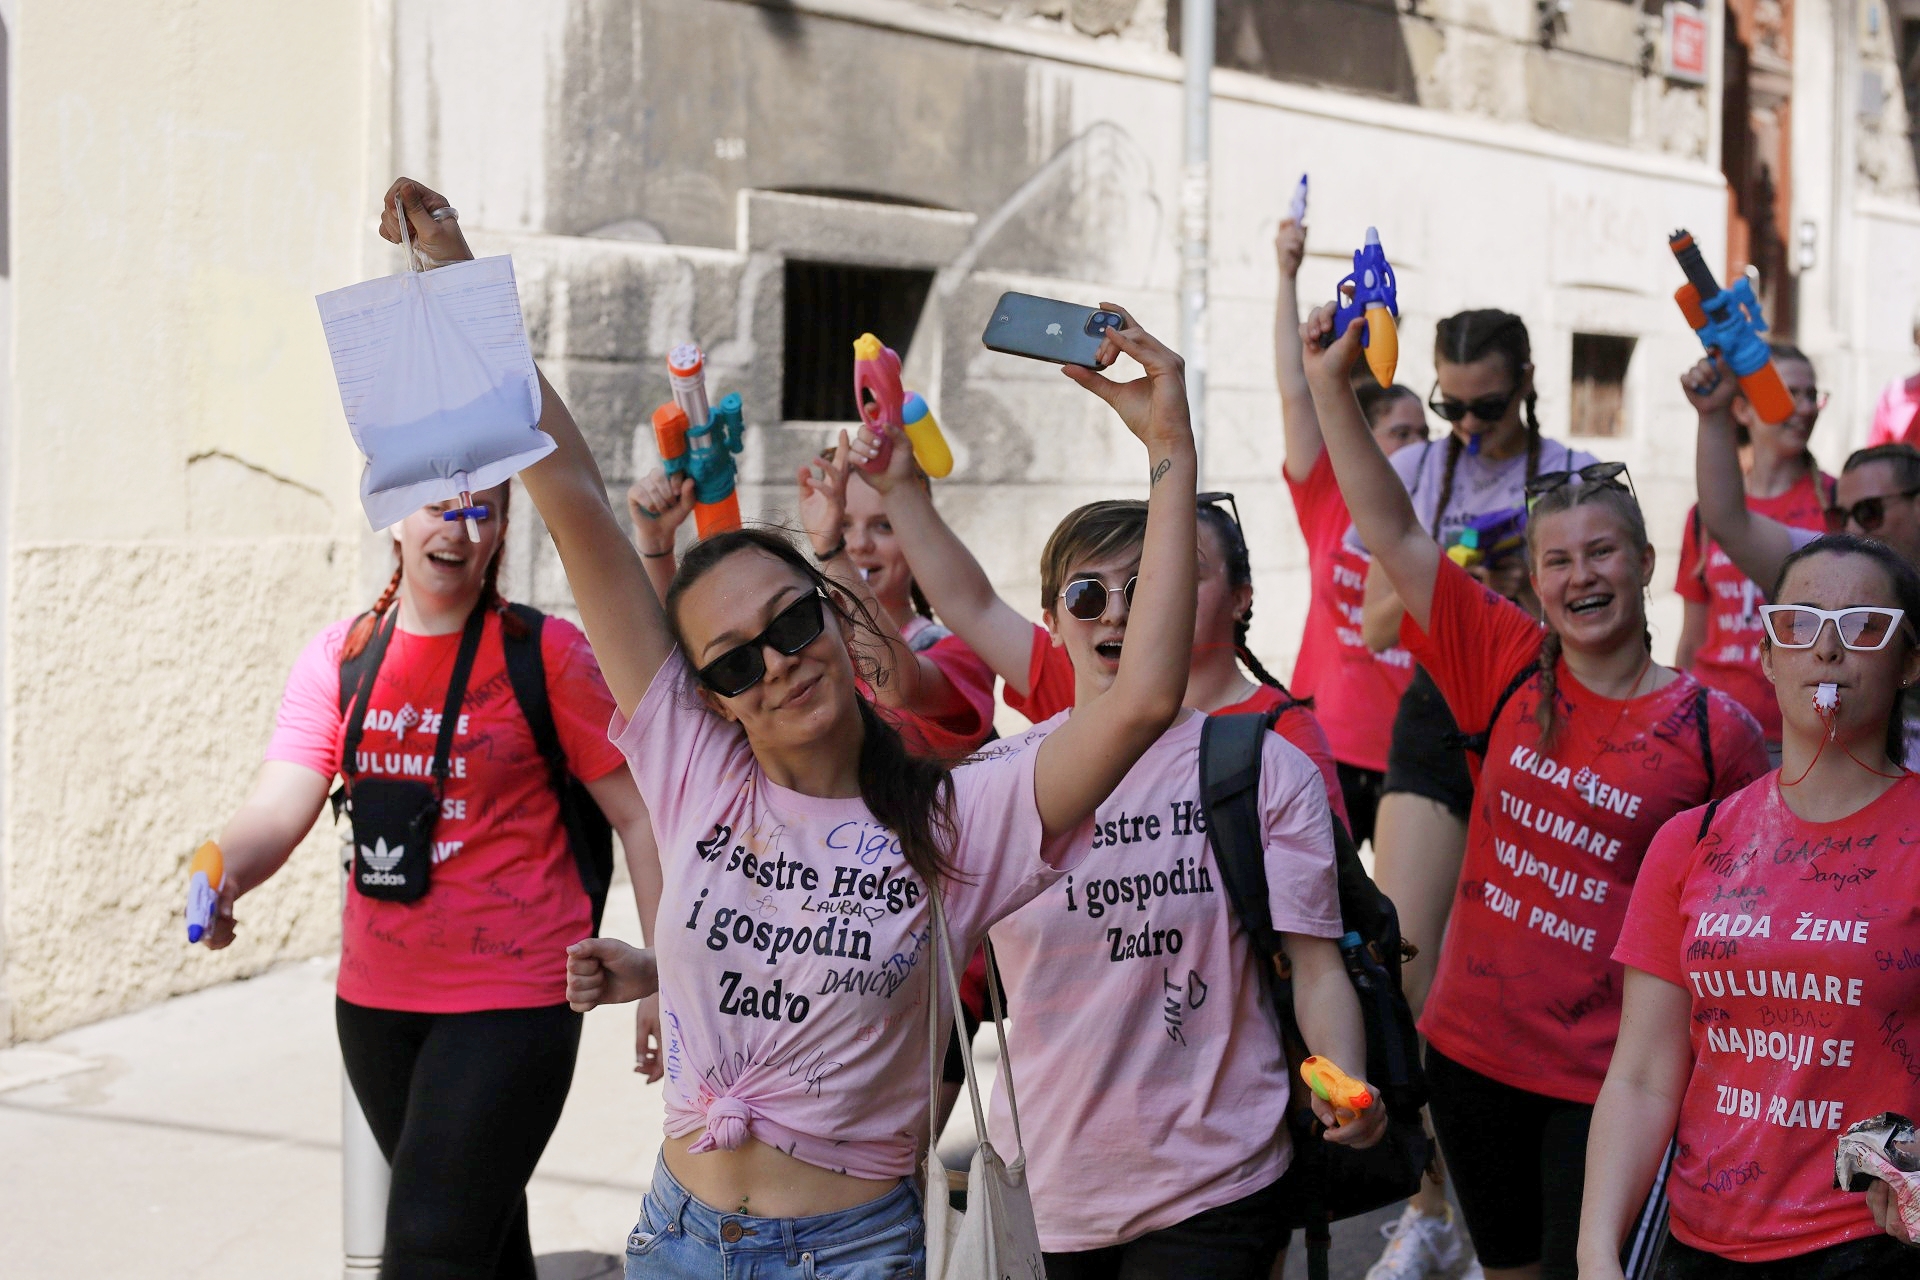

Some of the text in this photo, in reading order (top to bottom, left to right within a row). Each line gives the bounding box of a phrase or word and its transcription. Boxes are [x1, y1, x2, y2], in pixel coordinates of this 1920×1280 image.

[417, 708, 470, 736] ŽEE
[1509, 745, 1572, 790] KADA
[1584, 776, 1643, 820] ENE
[442, 798, 467, 820] SE
[1091, 811, 1161, 850] estre
[1500, 790, 1622, 863] TULUMARE
[361, 872, 406, 886] adidas
[726, 845, 819, 890] sestre
[829, 866, 920, 915] Helge
[1065, 857, 1215, 919] i gospodin
[1494, 836, 1579, 900] NAJBOLJI
[1580, 877, 1609, 904] SE
[686, 888, 872, 965] i gospodin
[801, 895, 862, 917] LAURA
[1483, 881, 1521, 922] ZUBI
[1528, 906, 1598, 953] PRAVE
[1694, 911, 1869, 944] KADA ŽENE
[1106, 920, 1184, 963] Zadro
[719, 971, 810, 1023] Zadro
[1689, 970, 1863, 1006] TULUMARE
[1707, 1027, 1855, 1071] NAJBOLJI SE
[1716, 1085, 1844, 1130] ZUBI PRAVE
